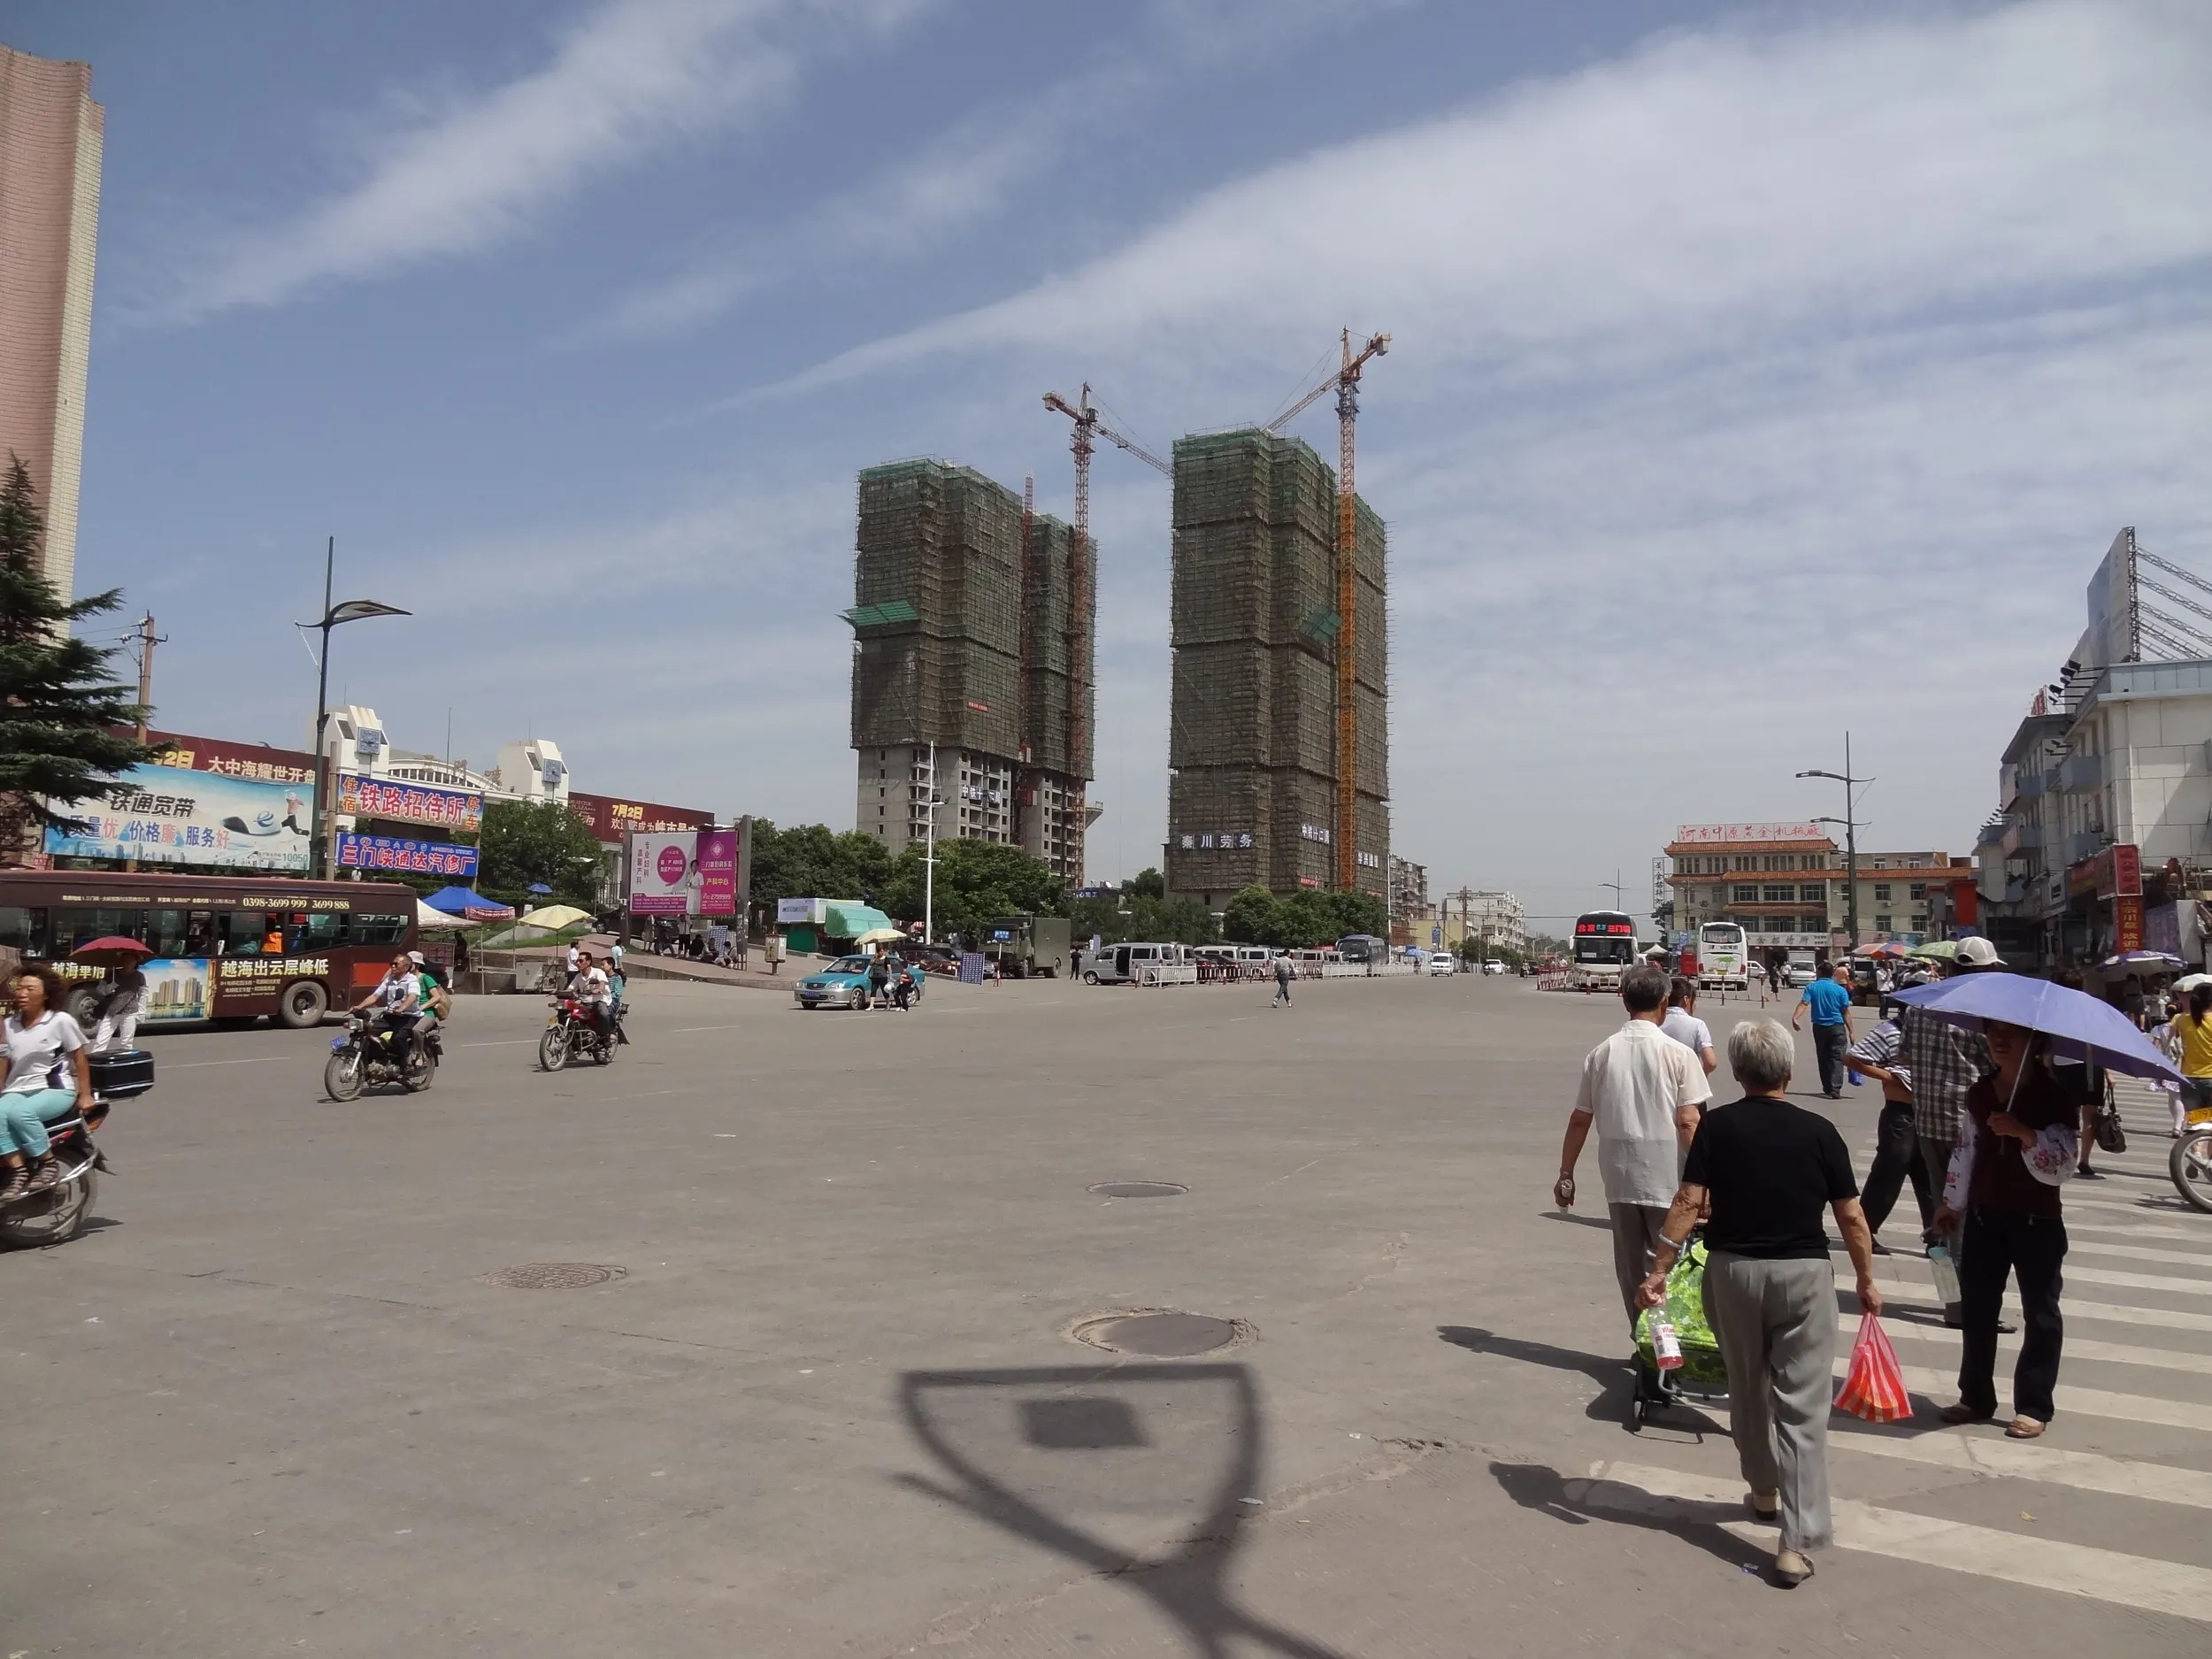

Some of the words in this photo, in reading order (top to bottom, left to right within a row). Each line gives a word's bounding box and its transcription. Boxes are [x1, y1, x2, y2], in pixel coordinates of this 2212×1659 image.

[208, 756, 316, 785] 大中海耀世开盘
[110, 792, 196, 818] 铁通宽带
[342, 777, 357, 813] 住宿
[359, 783, 465, 826] 铁路招待所
[465, 795, 480, 830] 停车
[611, 803, 643, 820] 7月2日
[129, 820, 177, 844] 价格廉
[186, 826, 230, 850] 服务好
[1181, 833, 1253, 849] 秦川劳务
[283, 853, 308, 863] 10050
[341, 845, 476, 875] 三门峡通达汽修厂
[220, 958, 329, 978] 越海出云层峰低
